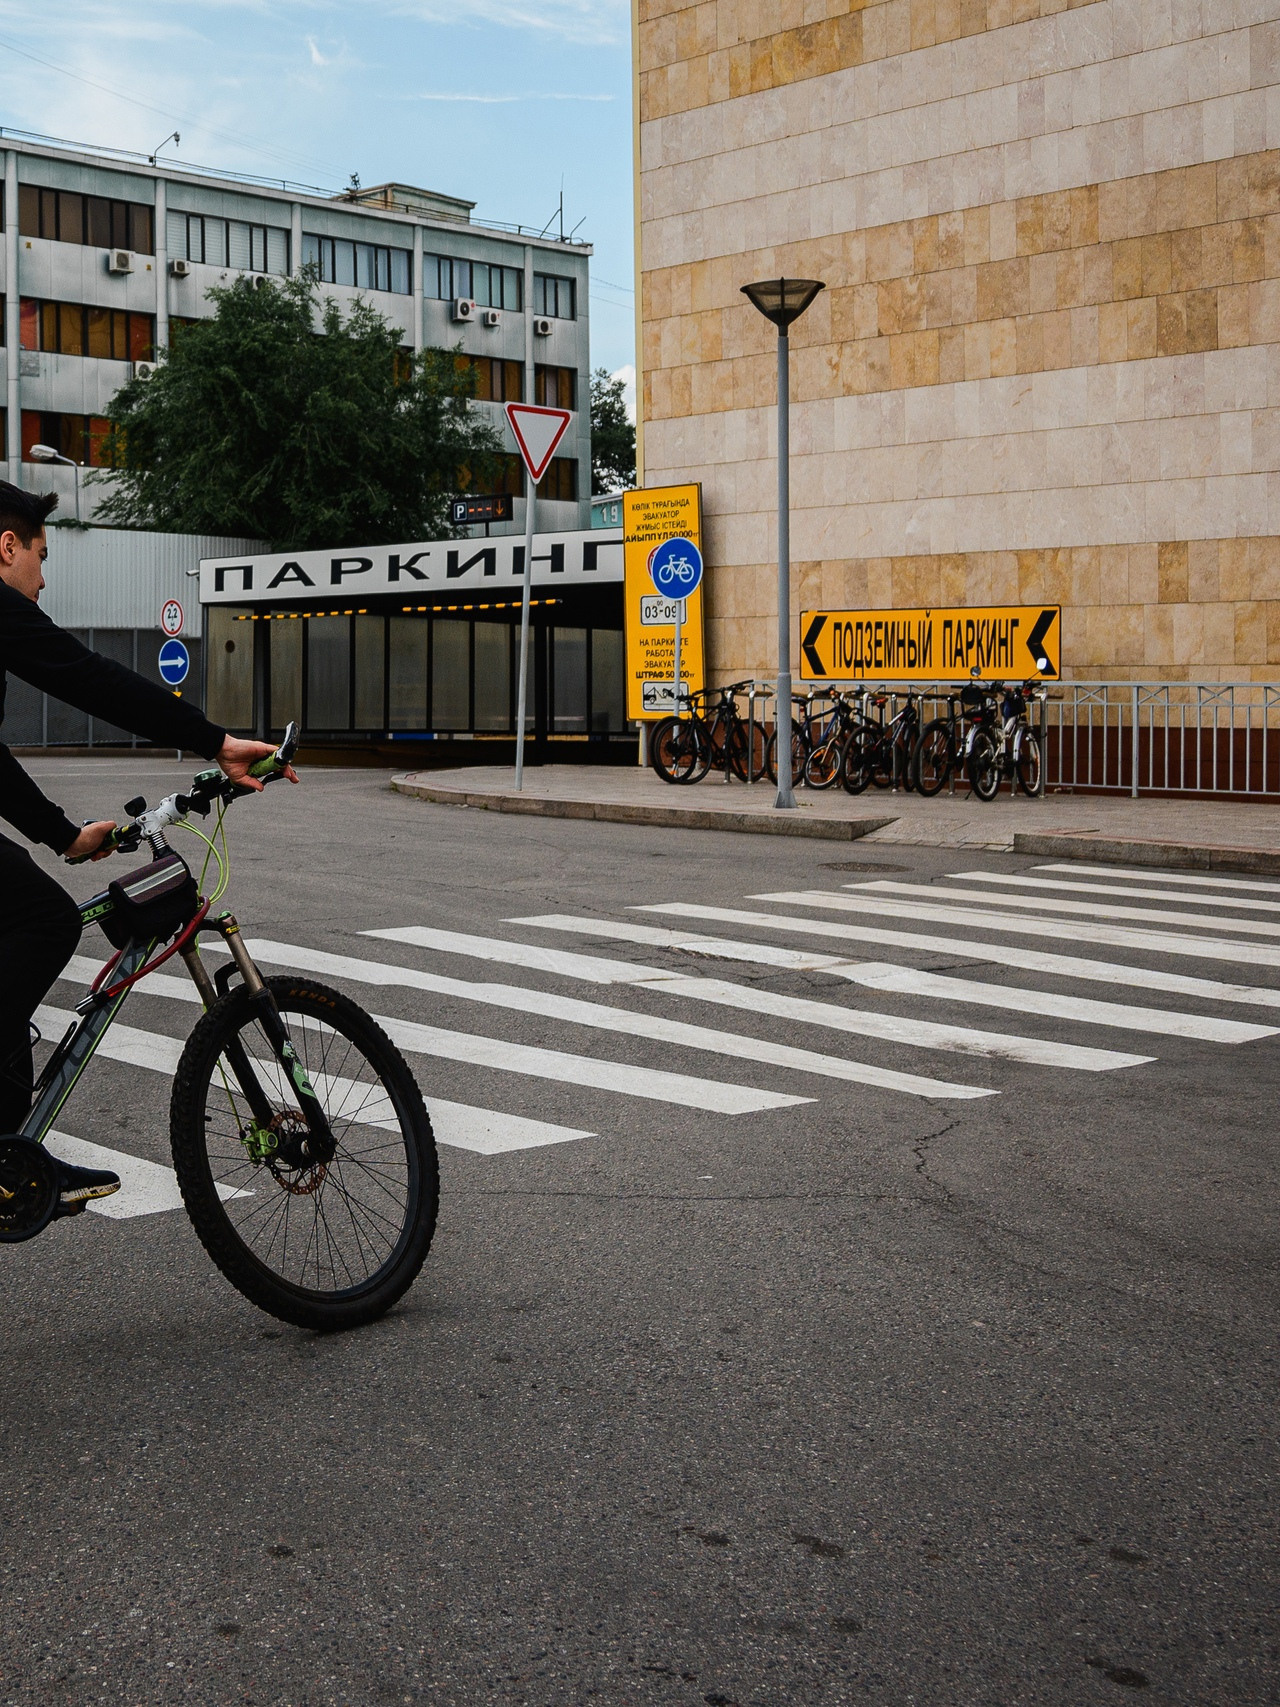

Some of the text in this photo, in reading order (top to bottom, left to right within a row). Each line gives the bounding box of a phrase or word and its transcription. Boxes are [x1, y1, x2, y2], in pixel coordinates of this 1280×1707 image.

[600, 504, 619, 523] 19
[643, 510, 680, 520] ЭВАКУАТОР
[214, 541, 623, 592] ПАРКИНГ
[651, 638, 689, 646] ПАРКИГЕ
[833, 610, 1020, 678] ПОДЗЕМНЫЙ ПАРКИНГ
[646, 649, 683, 657] РАБОТАТ
[644, 660, 686, 668] ЭВАКУАТР
[636, 670, 664, 679] ШТРАФ
